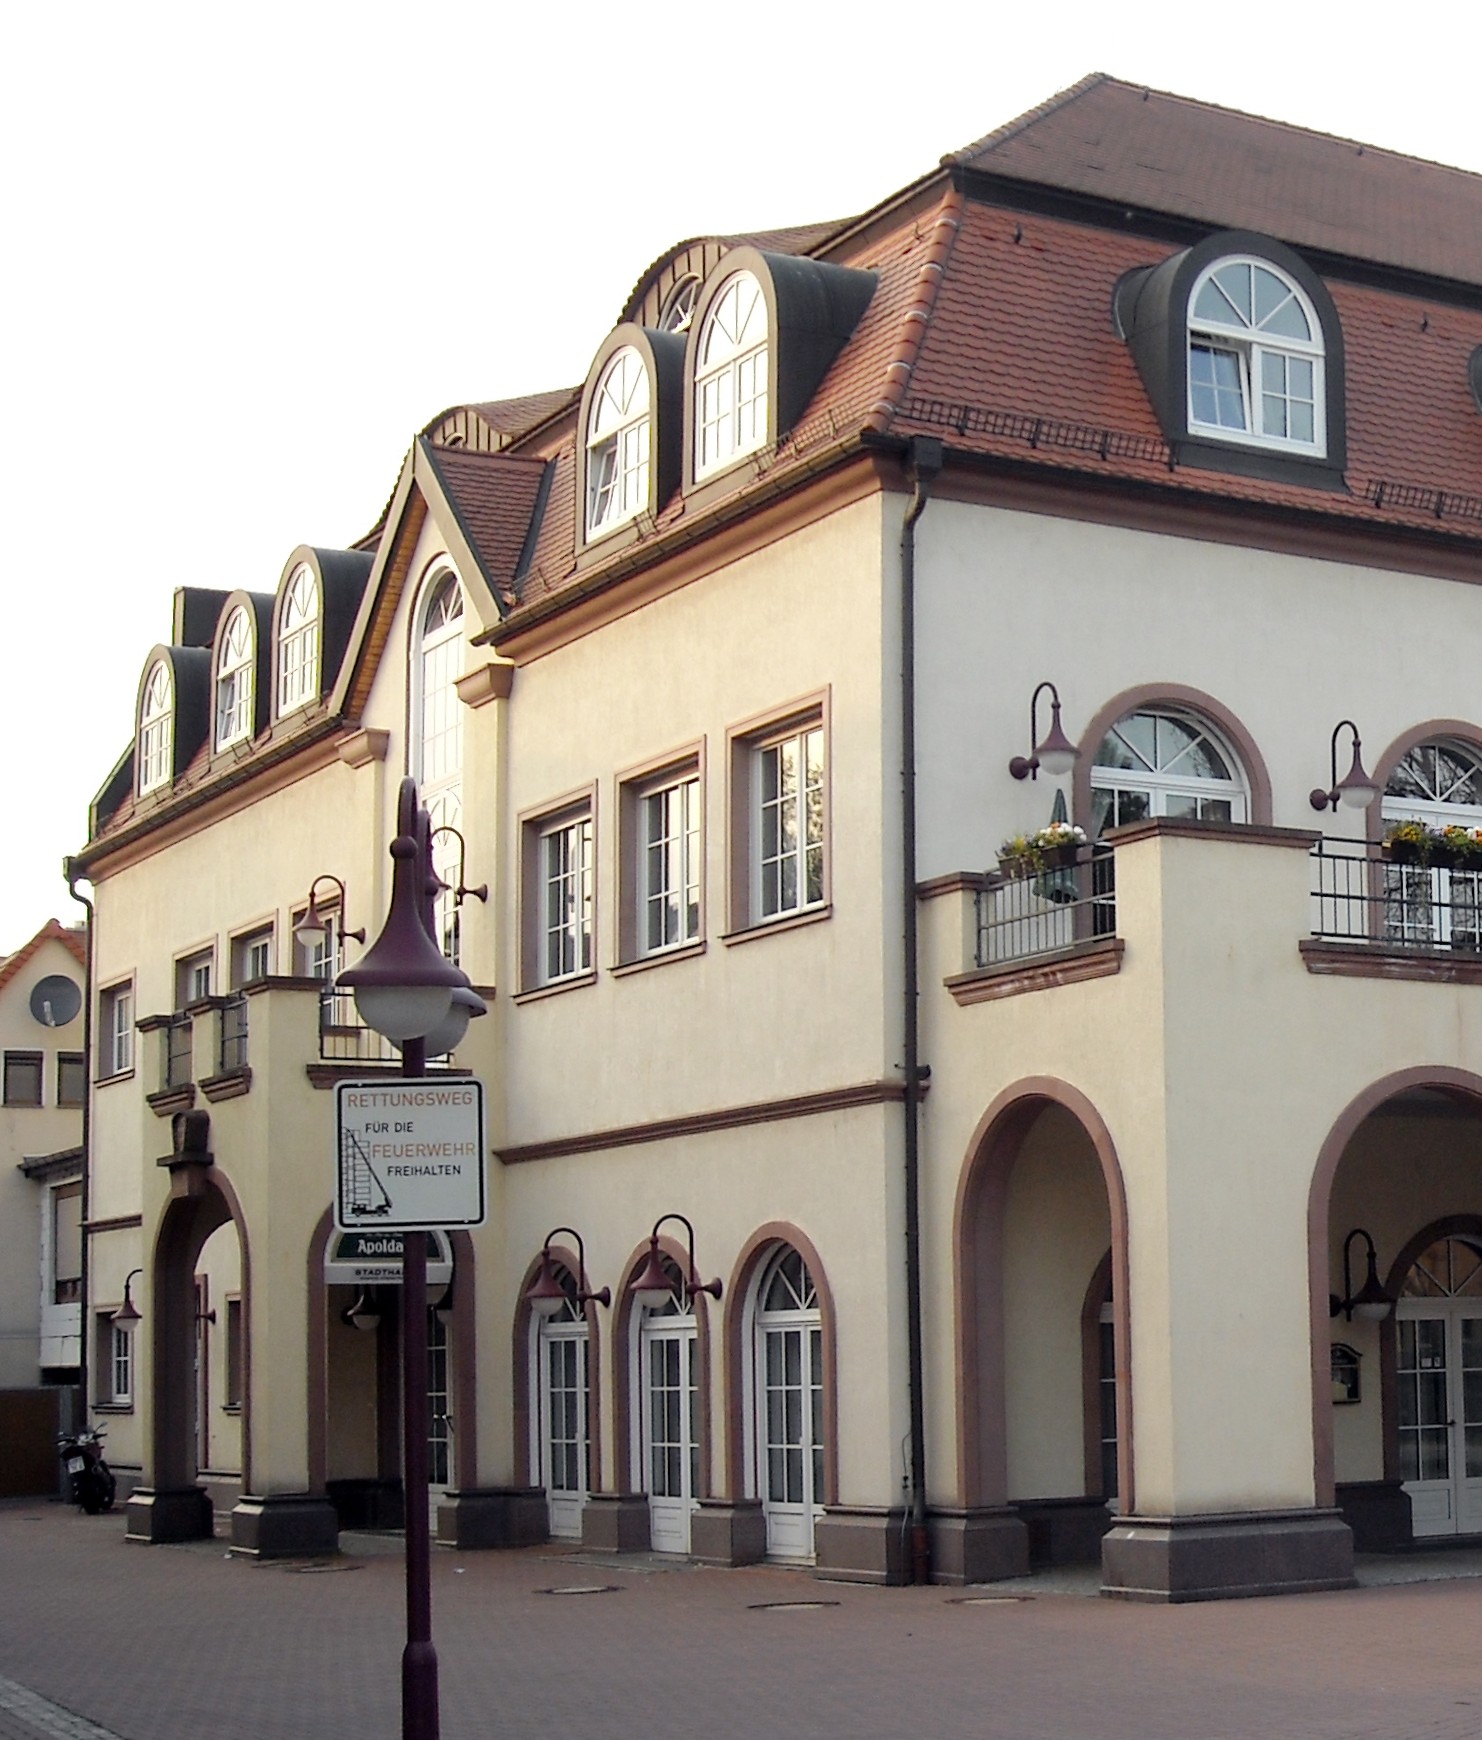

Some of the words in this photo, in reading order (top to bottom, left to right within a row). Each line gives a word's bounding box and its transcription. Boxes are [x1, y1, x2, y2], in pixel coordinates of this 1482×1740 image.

[348, 1092, 473, 1107] RETTUNGSWEG
[365, 1122, 389, 1133] FÜR
[394, 1122, 414, 1133] DIE
[372, 1143, 476, 1158] FEUERWEHR
[387, 1165, 461, 1176] FREIHALTEN
[357, 1239, 404, 1255] Apolda
